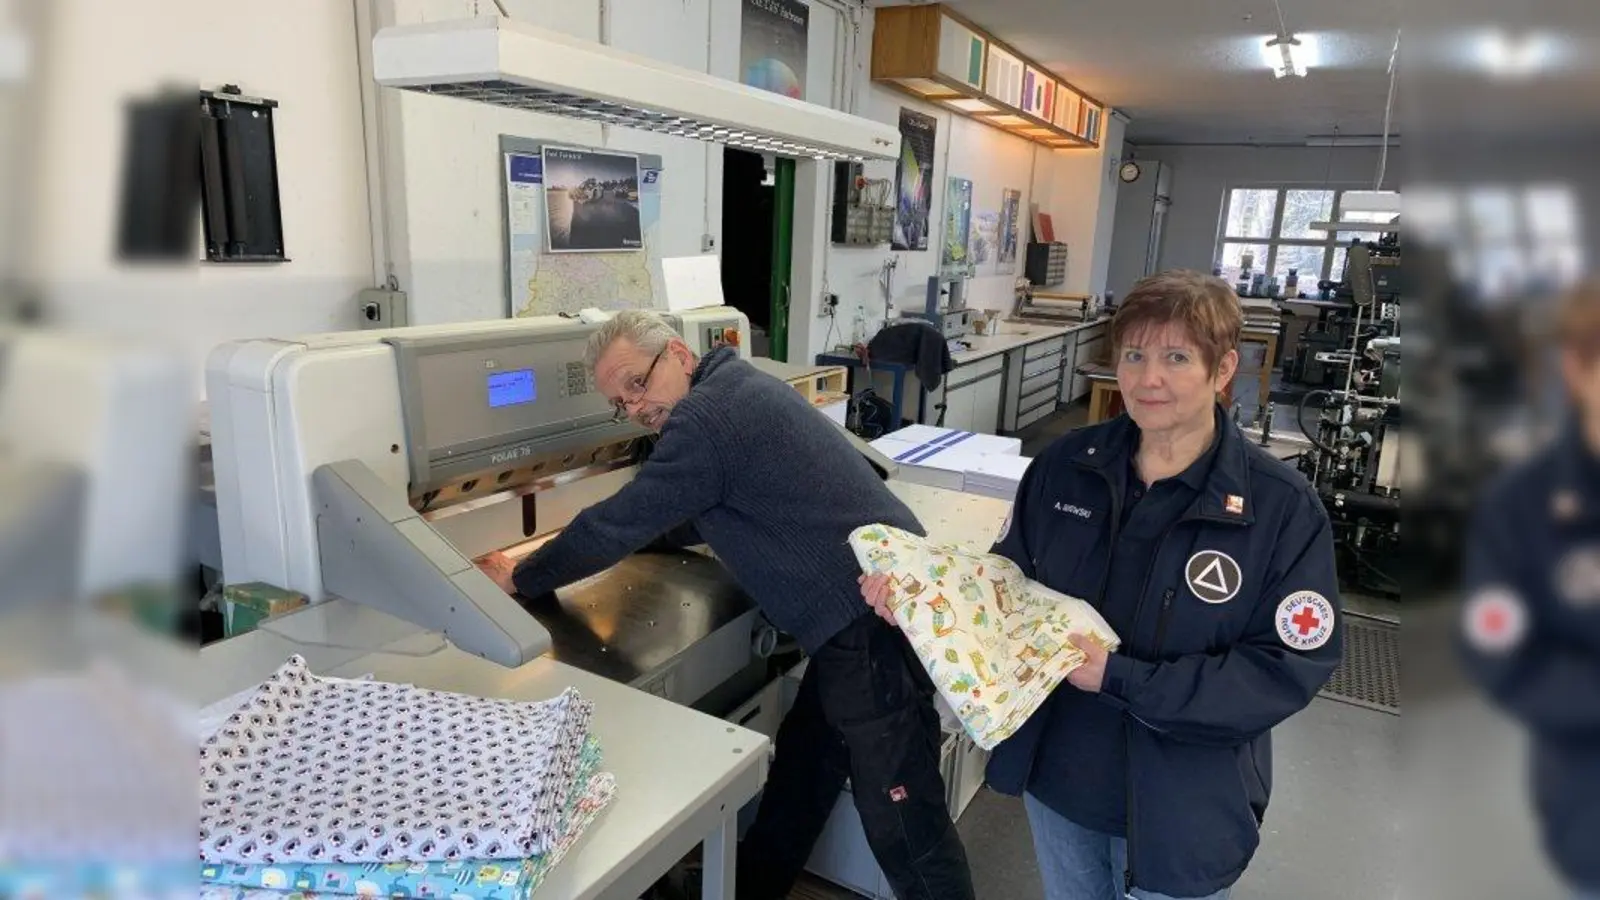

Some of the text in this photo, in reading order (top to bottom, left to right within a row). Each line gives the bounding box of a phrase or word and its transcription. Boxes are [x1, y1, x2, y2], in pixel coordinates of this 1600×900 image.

[490, 448, 518, 464] POLAR
[1285, 596, 1329, 620] DEUTSCHES
[1281, 617, 1327, 645] ROTES KREUZ
